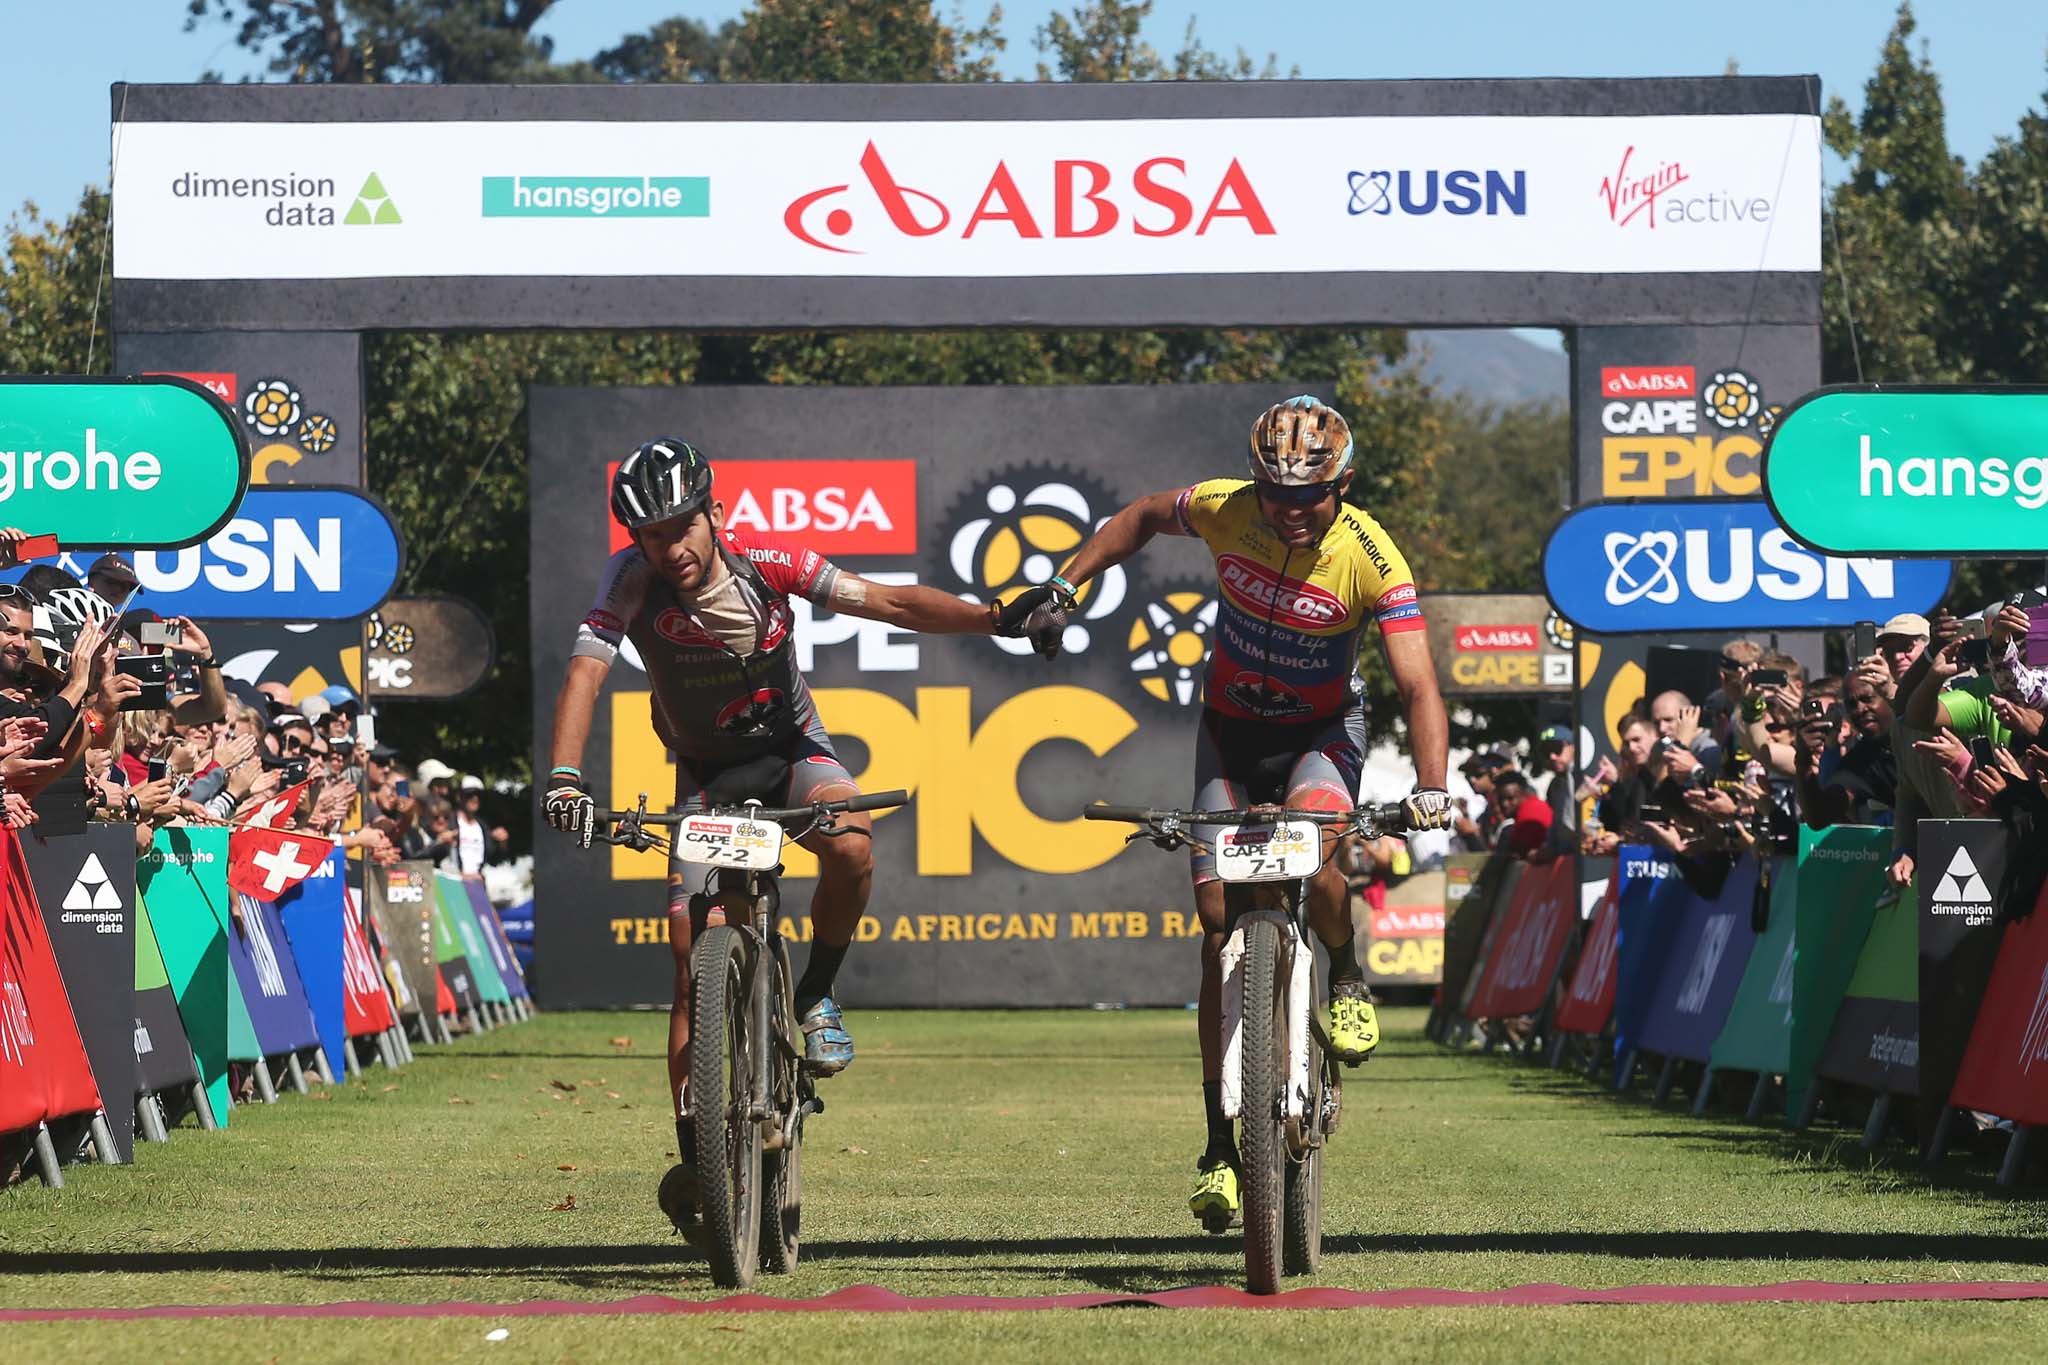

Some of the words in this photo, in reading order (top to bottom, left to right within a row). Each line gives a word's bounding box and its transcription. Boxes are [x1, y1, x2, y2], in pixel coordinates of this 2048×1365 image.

[172, 172, 335, 198] dimension
[513, 177, 682, 214] hansgrohe
[961, 157, 1277, 239] ABSA
[1399, 170, 1527, 215] USN
[1599, 146, 1690, 229] Virgin
[265, 203, 335, 226] data
[1665, 190, 1771, 223] active
[1637, 374, 1689, 391] ABSA
[1601, 400, 1697, 434] CAPE
[1602, 434, 1764, 497] EPIC
[1860, 435, 2048, 509] hansg
[728, 487, 894, 532] ABSA
[134, 518, 341, 592] USN
[1685, 528, 1895, 603] USN
[1223, 563, 1337, 620] PLASCON
[1223, 622, 1331, 671] POLIMEDICAL
[1271, 629, 1294, 643] FOR
[1297, 633, 1329, 656] Life
[1487, 630, 1534, 647] ABSA
[1452, 655, 1539, 685] CAPE
[686, 832, 731, 846] CAPE
[733, 836, 774, 849] EPIC
[706, 846, 750, 862] 7-2
[1222, 844, 1268, 858] CAPE
[1272, 841, 1311, 856] EPIC
[1810, 843, 1880, 862] hansgrohe
[144, 848, 214, 866] hansgrohe
[1250, 857, 1287, 874] 7-1
[61, 911, 123, 923] dimension
[1407, 911, 1445, 931] ABS
[1931, 903, 1993, 915] dimension
[96, 922, 124, 934] data
[892, 911, 1058, 941] AFRICAN
[1070, 911, 1150, 938] MTB
[1161, 911, 1206, 937] RA
[1367, 938, 1445, 975] CAP
